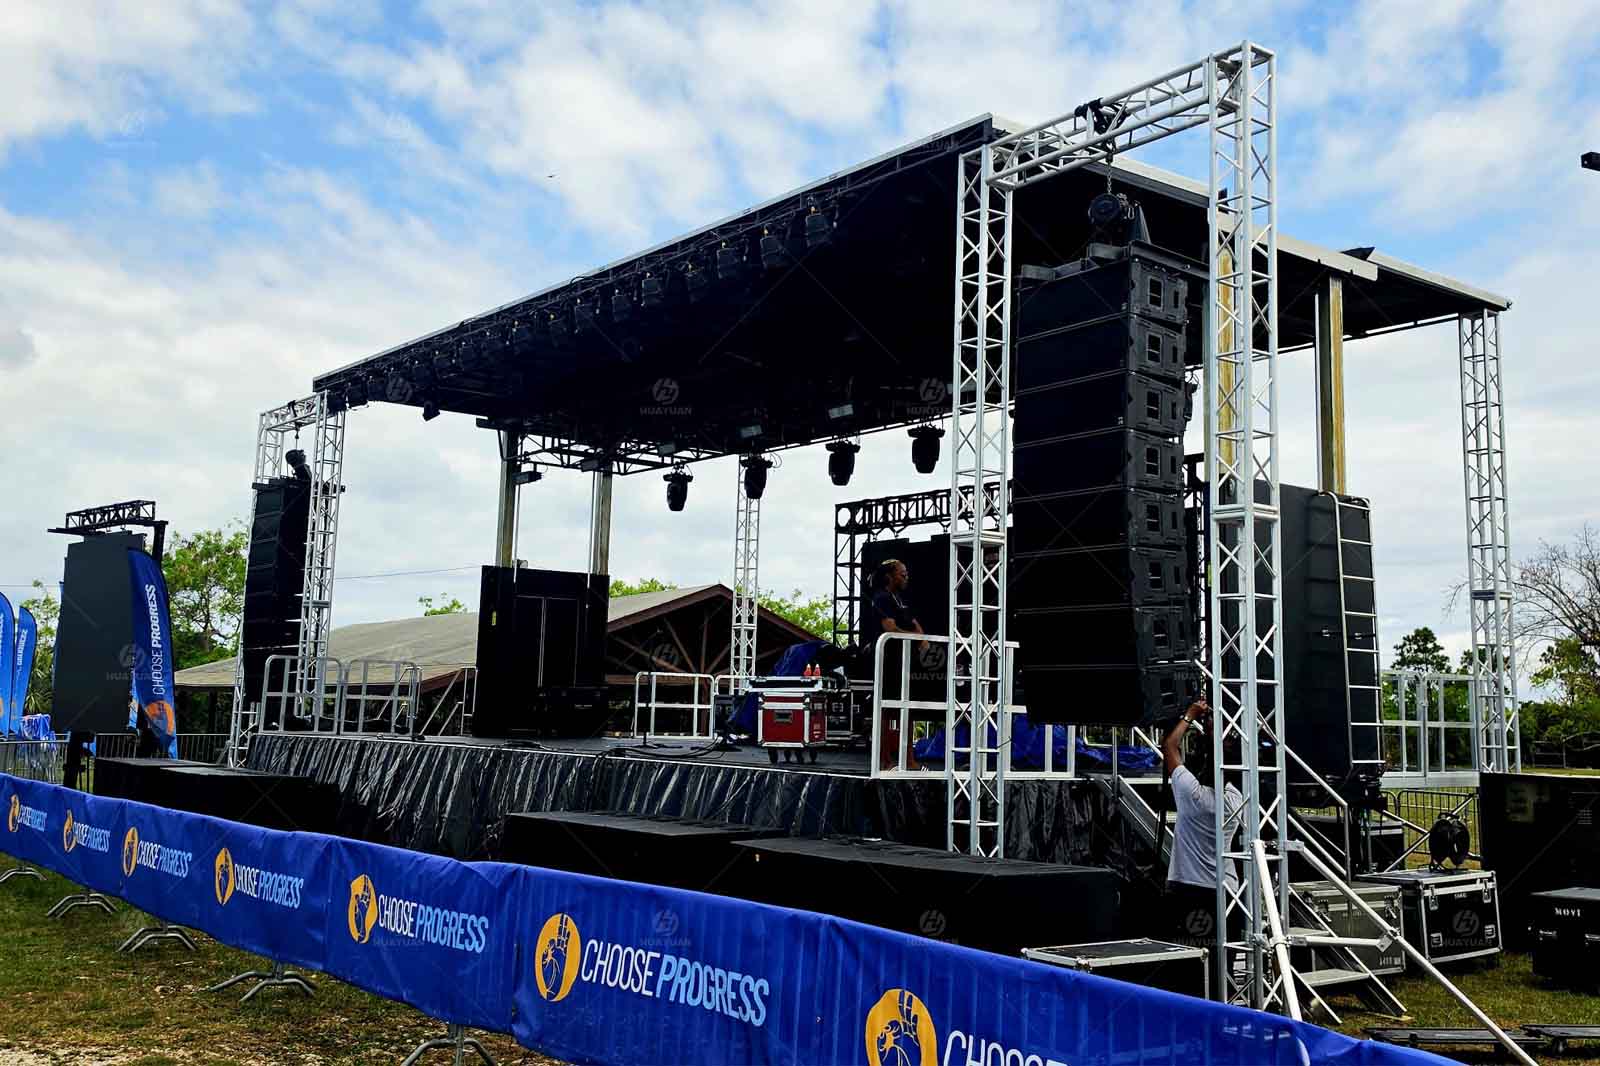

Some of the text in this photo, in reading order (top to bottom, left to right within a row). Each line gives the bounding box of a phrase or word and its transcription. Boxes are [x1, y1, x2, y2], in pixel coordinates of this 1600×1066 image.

[145, 584, 165, 695] CHOOSE PROGRESS
[136, 840, 192, 878] CHOOSE PROGRESS
[234, 863, 304, 909] CHOOSE PROGRESS
[378, 894, 489, 954] CHOOSE PROGRESS
[581, 939, 770, 1027] CHOOSE PROGRESS
